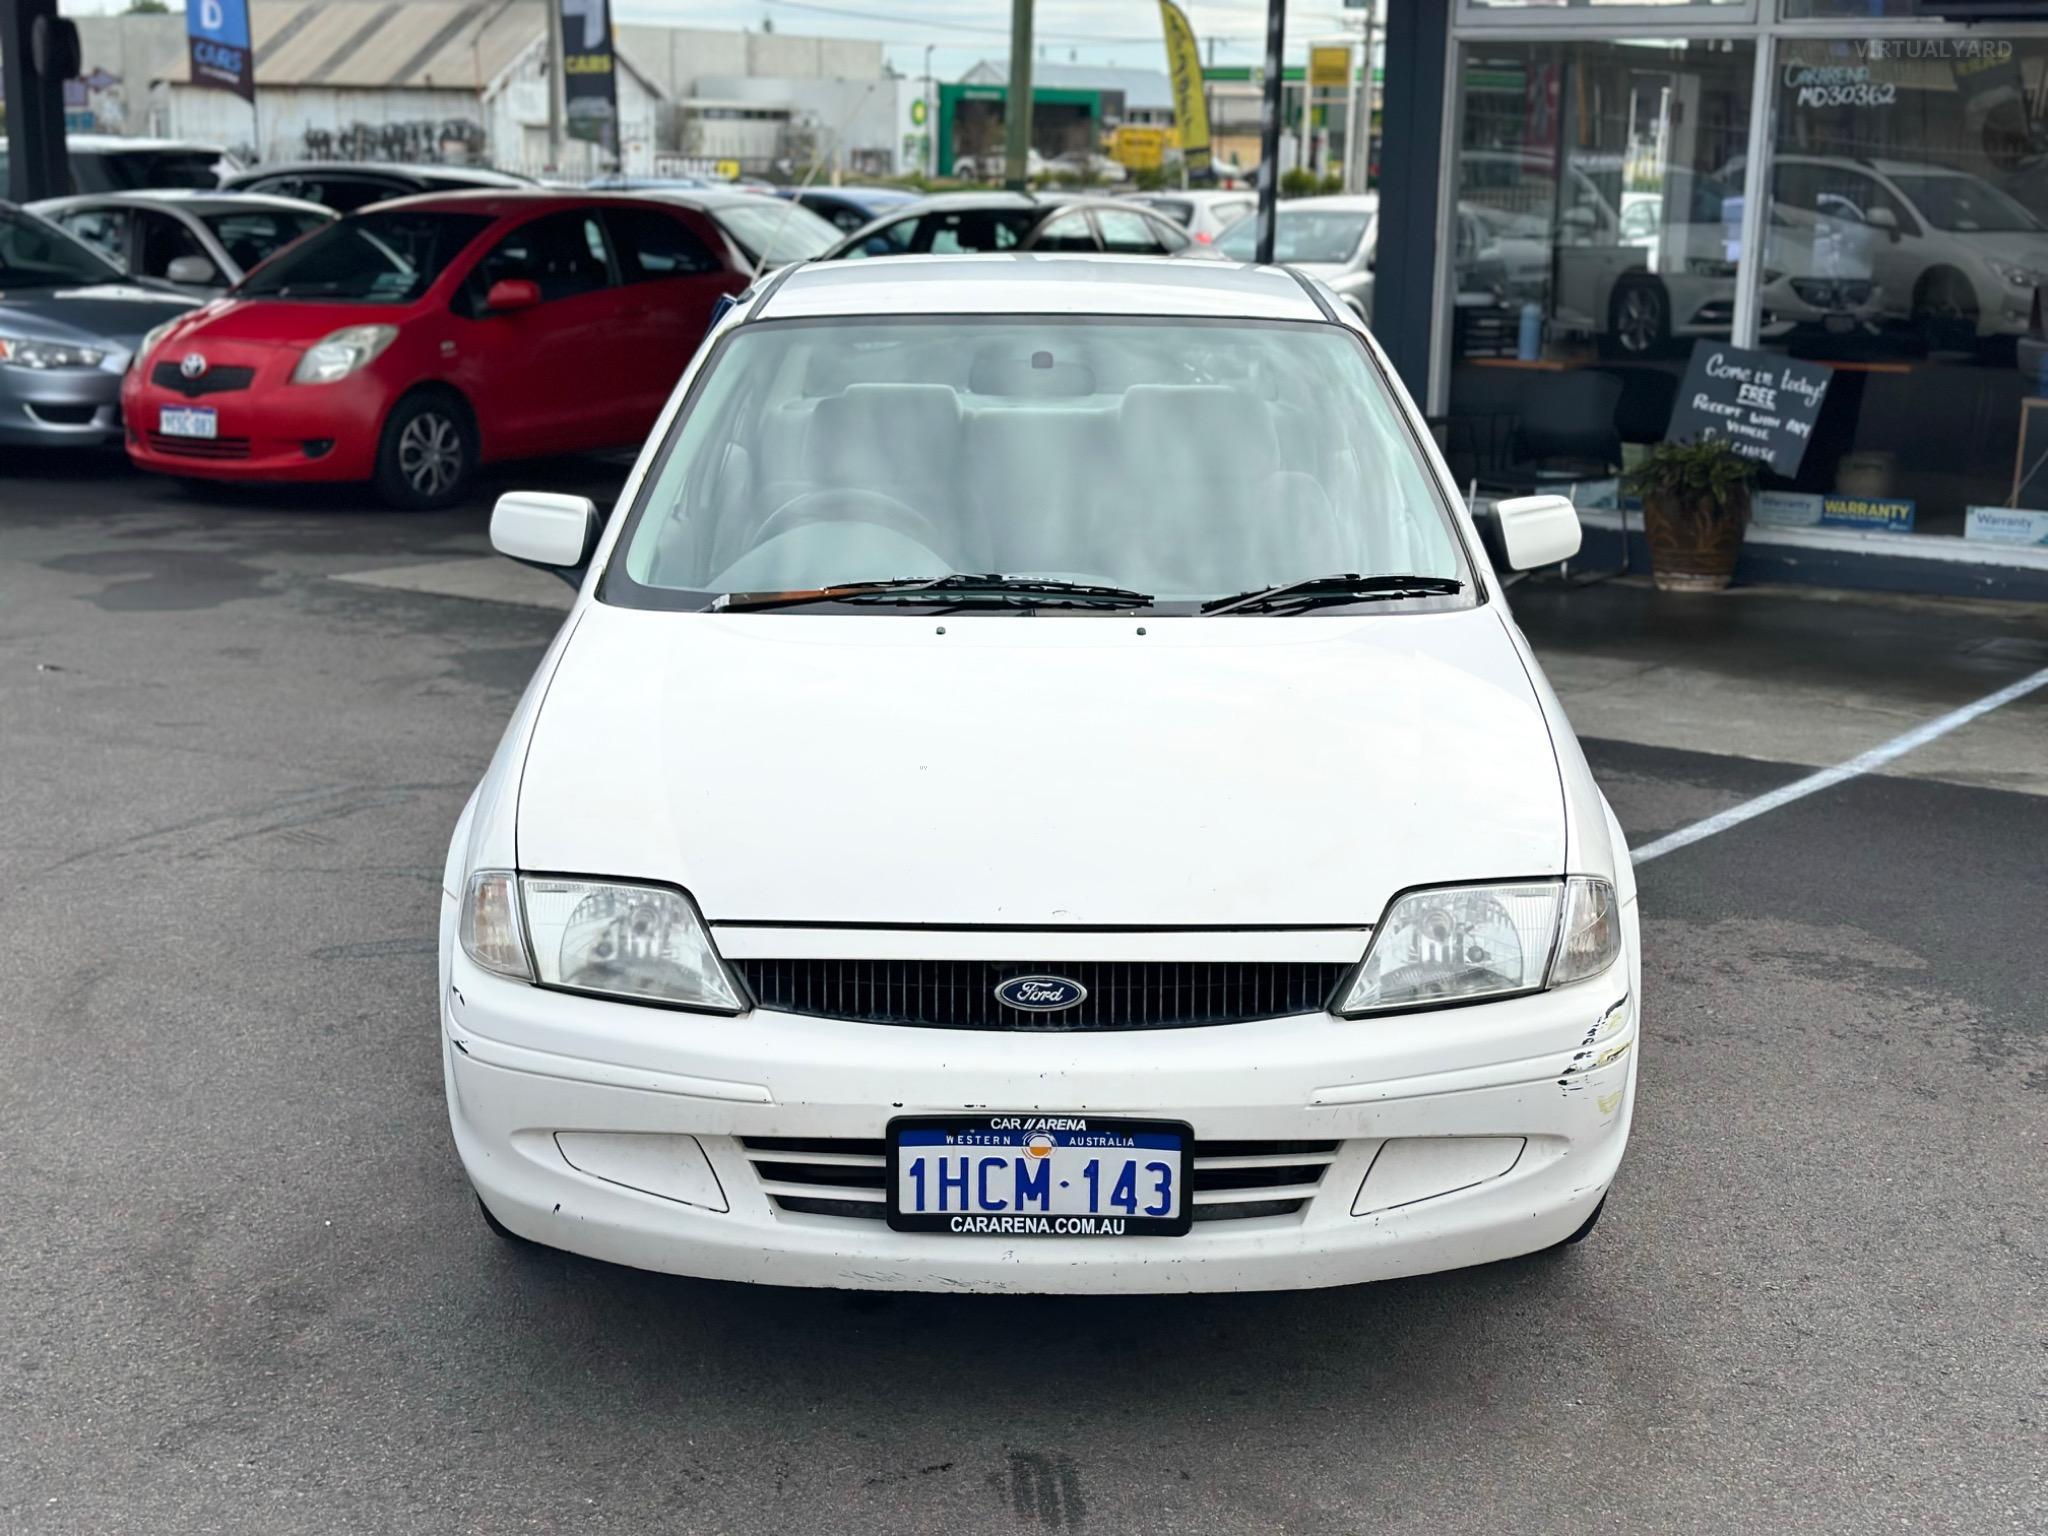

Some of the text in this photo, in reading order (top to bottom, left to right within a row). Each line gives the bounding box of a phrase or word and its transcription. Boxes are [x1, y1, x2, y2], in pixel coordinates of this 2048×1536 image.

[194, 42, 242, 73] CARS
[565, 54, 612, 74] CARS
[1705, 353, 1752, 381] Come
[1738, 383, 1777, 408] FREE
[1824, 500, 1911, 519] WARRANTY
[1016, 981, 1064, 1001] Ford
[945, 1135, 1135, 1147] WESTERN AUSTRALIA
[950, 1216, 1126, 1235] CARARENA.COM.AU
